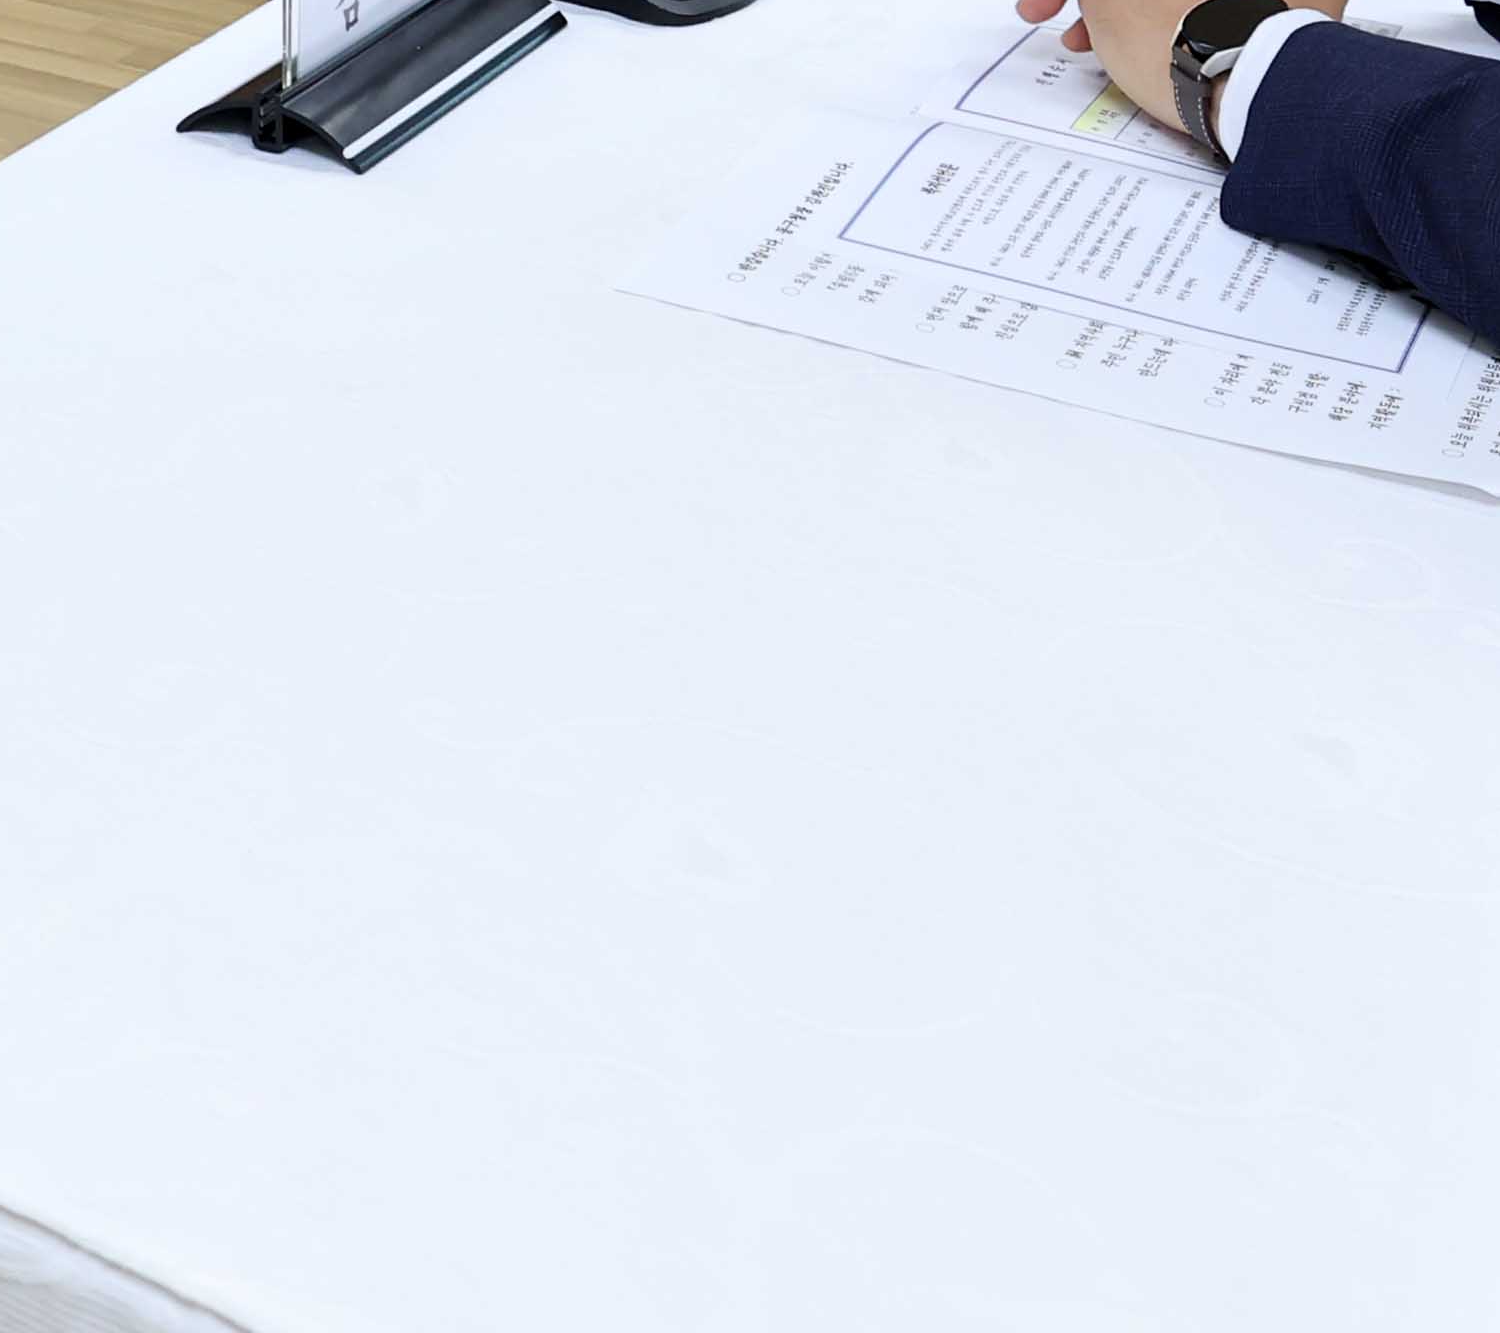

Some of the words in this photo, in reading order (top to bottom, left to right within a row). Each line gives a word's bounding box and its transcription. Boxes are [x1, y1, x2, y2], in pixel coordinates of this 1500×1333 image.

[739, 238, 783, 271] 반갑습니다.
[776, 205, 812, 235] 동구청장
[805, 162, 854, 204] 김찬진입니다.
[1450, 433, 1474, 448] 오늘
